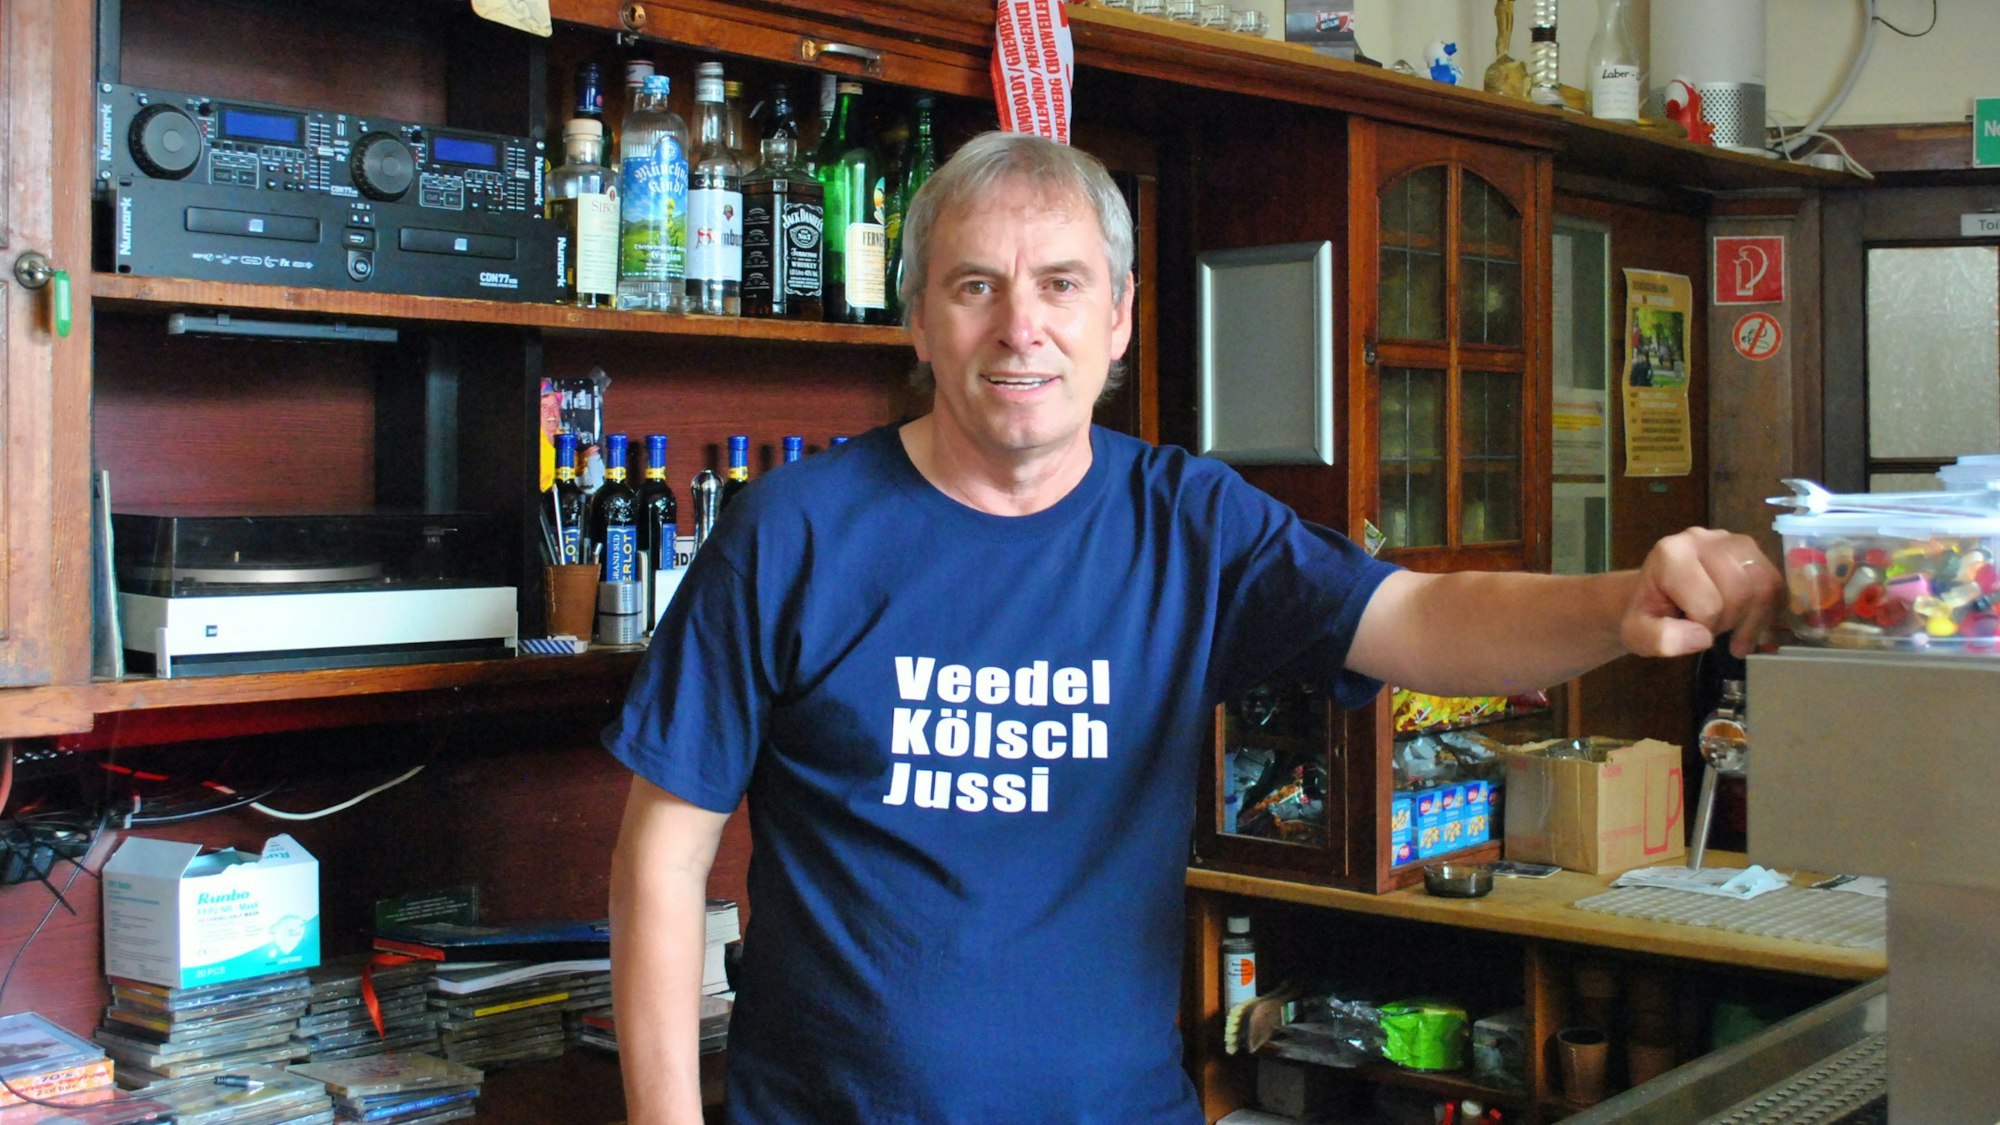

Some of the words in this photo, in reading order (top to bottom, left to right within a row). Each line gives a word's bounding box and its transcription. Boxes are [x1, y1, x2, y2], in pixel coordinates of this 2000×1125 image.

[101, 103, 112, 161] Numark
[534, 156, 544, 206] Numark
[119, 197, 132, 256] Numark
[782, 211, 800, 229] JACK
[556, 236, 567, 288] Numark
[612, 534, 620, 552] SUD
[894, 656, 1110, 706] Veedel
[891, 707, 1108, 760] Kölsch
[882, 762, 1049, 813] Jussi
[197, 889, 251, 905] Runbo
